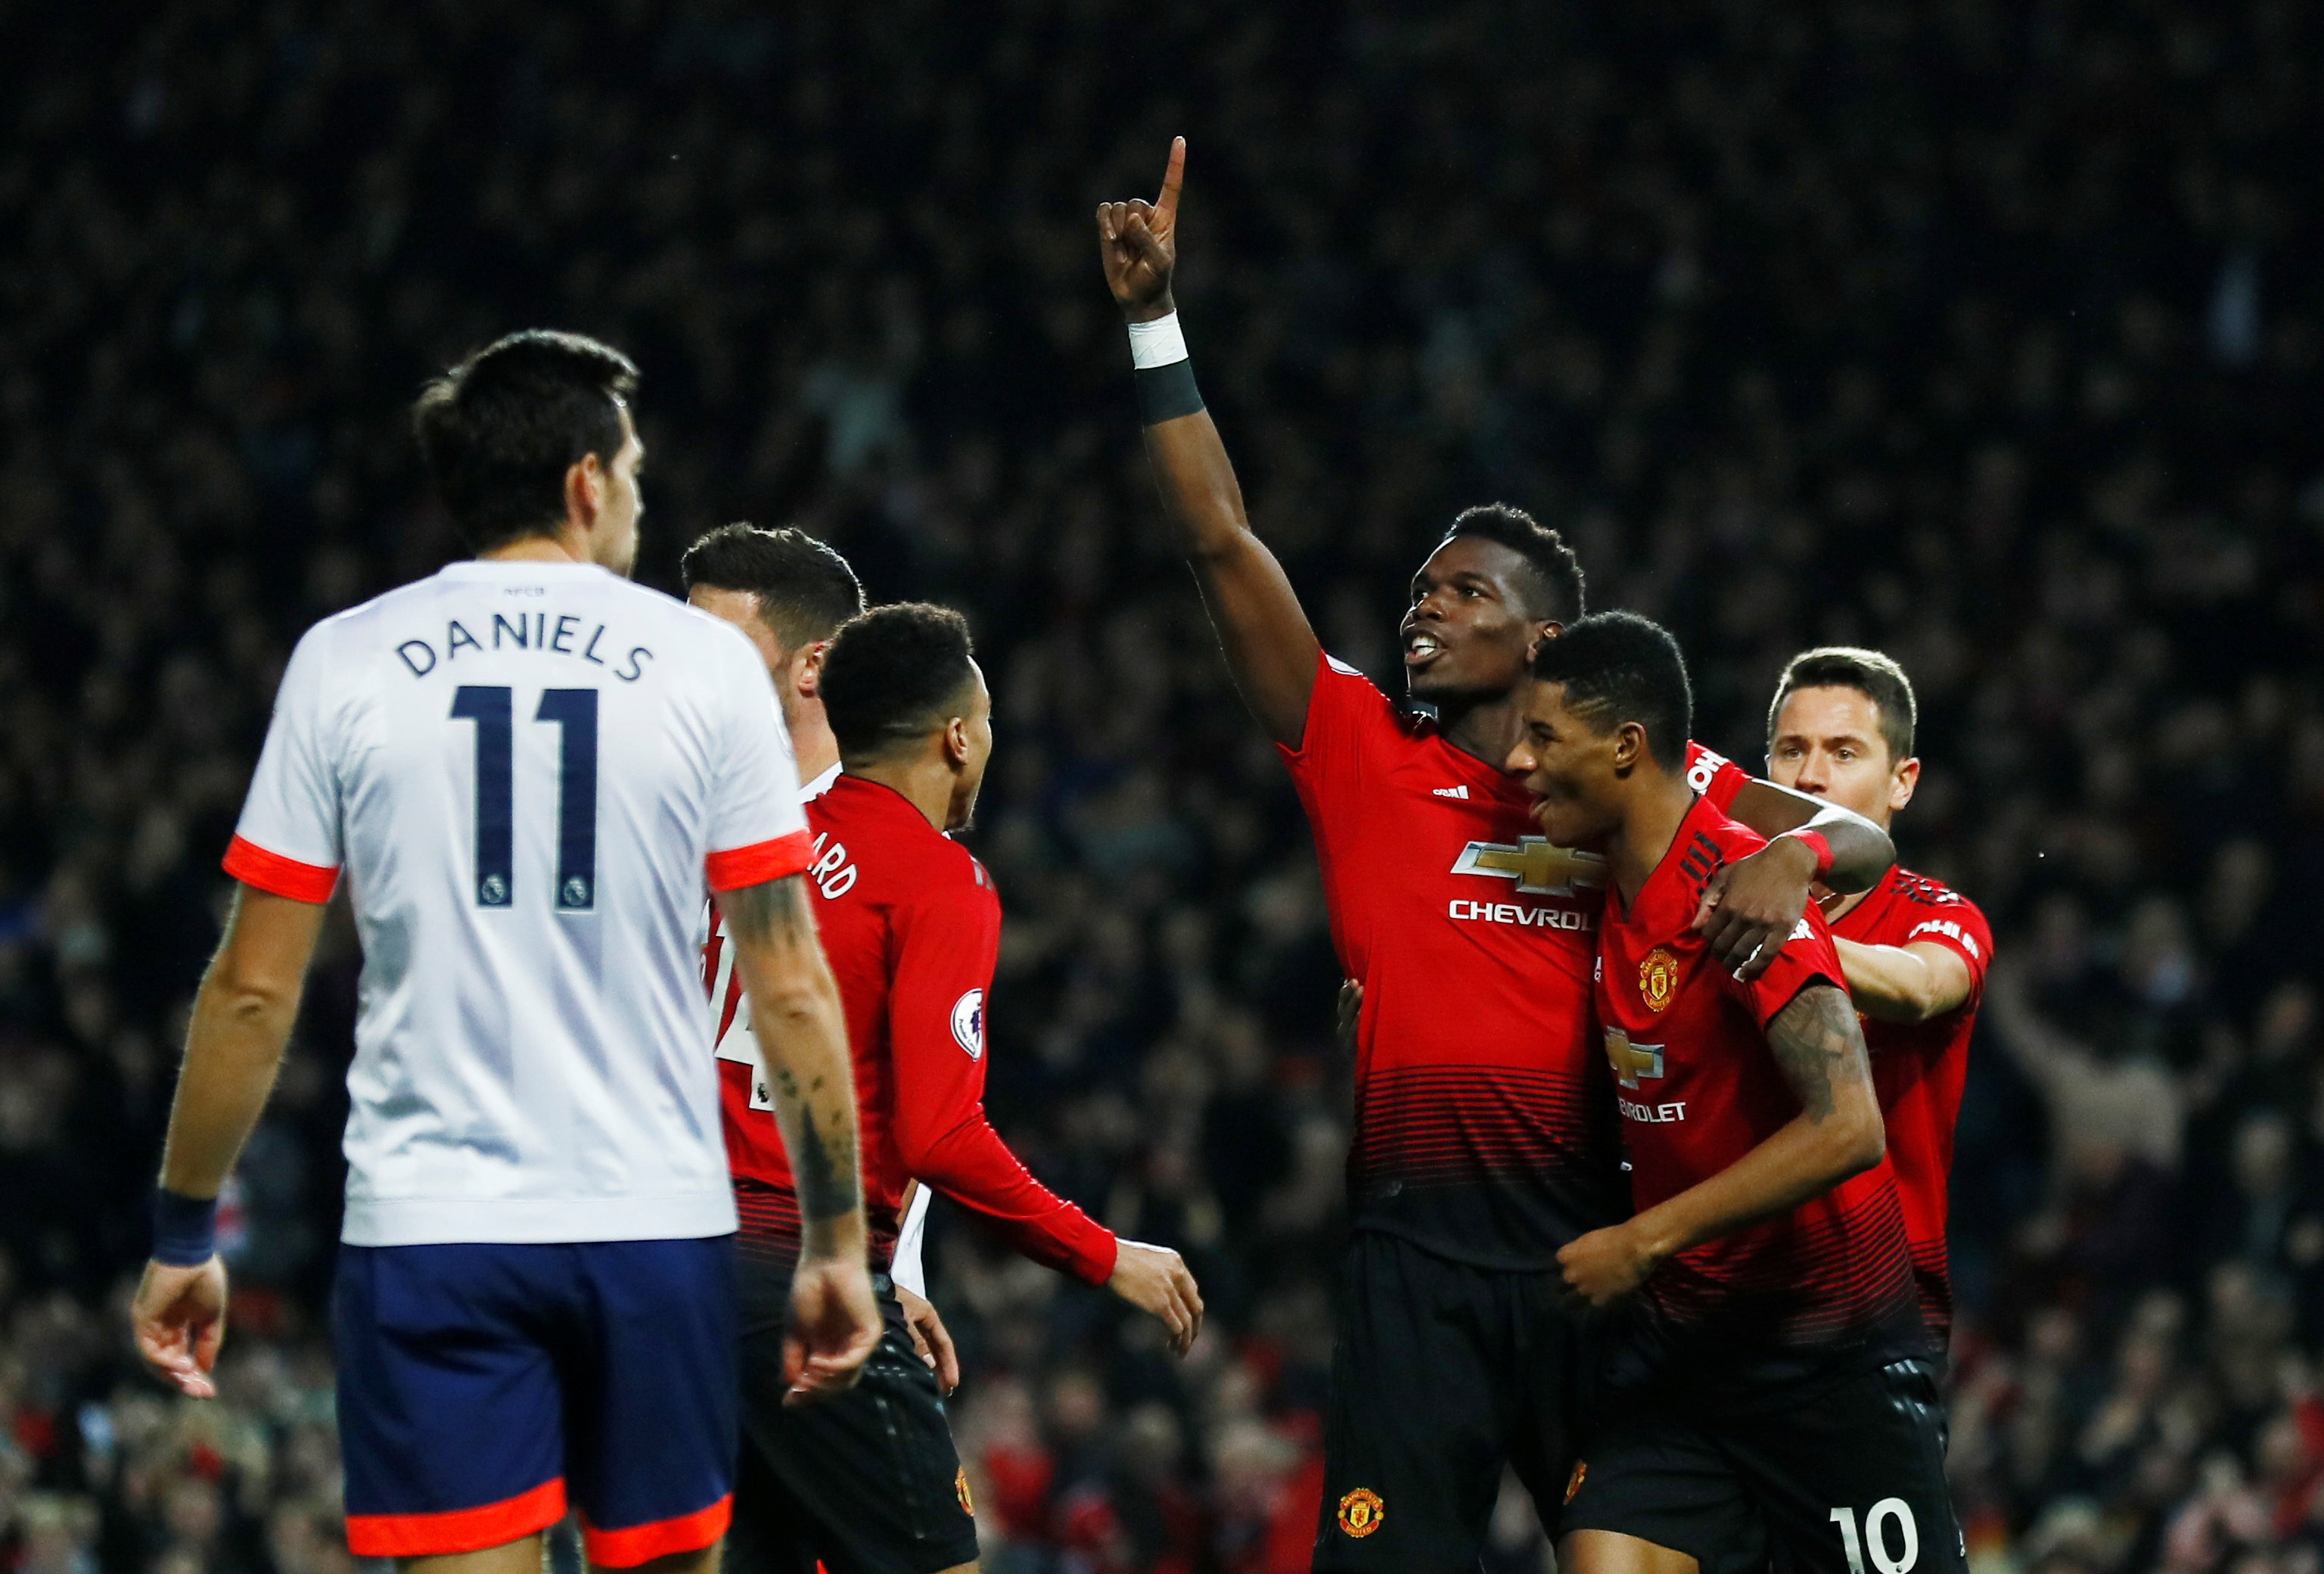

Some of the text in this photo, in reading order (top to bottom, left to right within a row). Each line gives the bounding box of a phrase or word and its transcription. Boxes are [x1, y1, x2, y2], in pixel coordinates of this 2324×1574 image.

[394, 613, 654, 683] DANIELS
[449, 686, 598, 908] 11
[1829, 1497, 1919, 1574] 10
